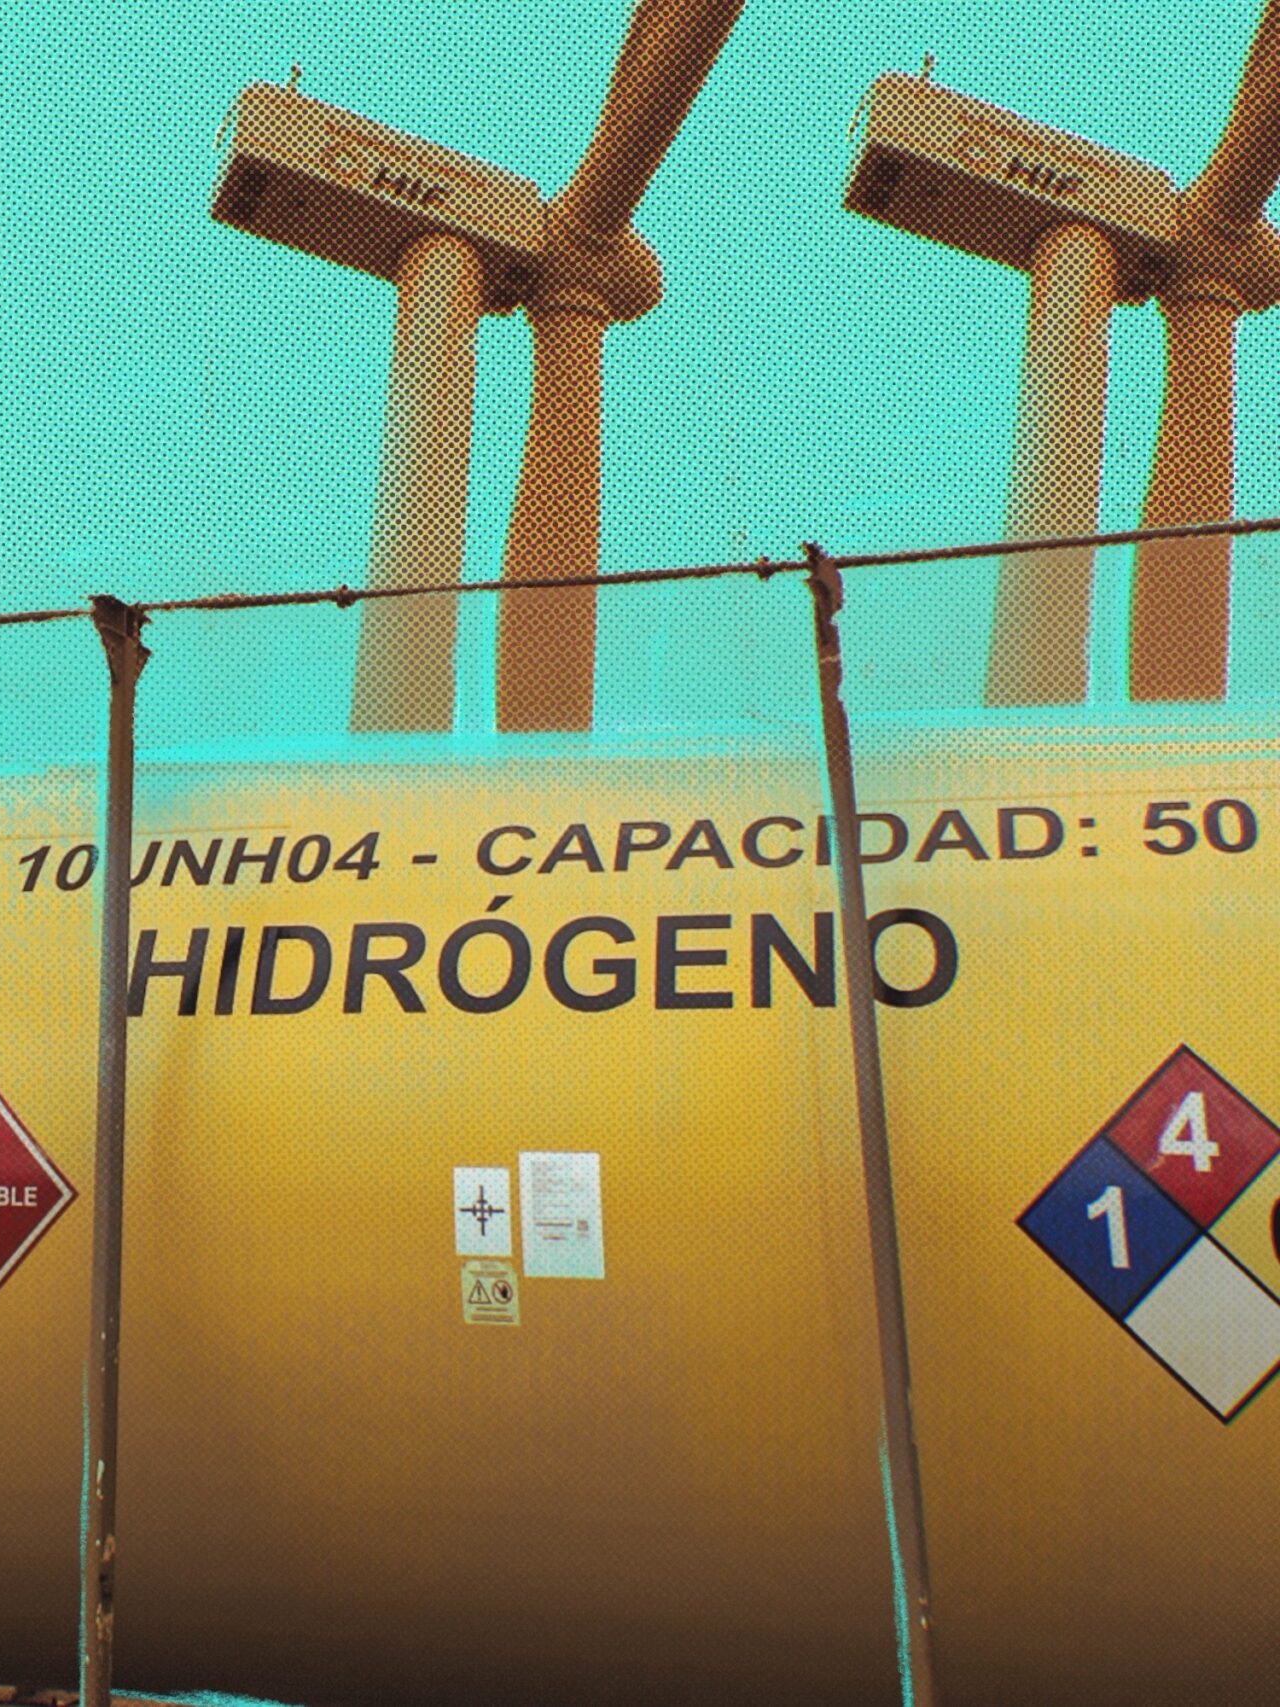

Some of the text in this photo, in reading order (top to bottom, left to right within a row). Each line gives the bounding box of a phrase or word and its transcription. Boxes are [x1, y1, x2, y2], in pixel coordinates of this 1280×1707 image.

[411, 853, 438, 864] -
[476, 806, 1099, 875] CAPACIDAD:
[1143, 798, 1258, 855] 50
[125, 896, 960, 1017] HIDRÓGENO
[1158, 1091, 1219, 1172] 4
[1086, 1185, 1130, 1269] 1
